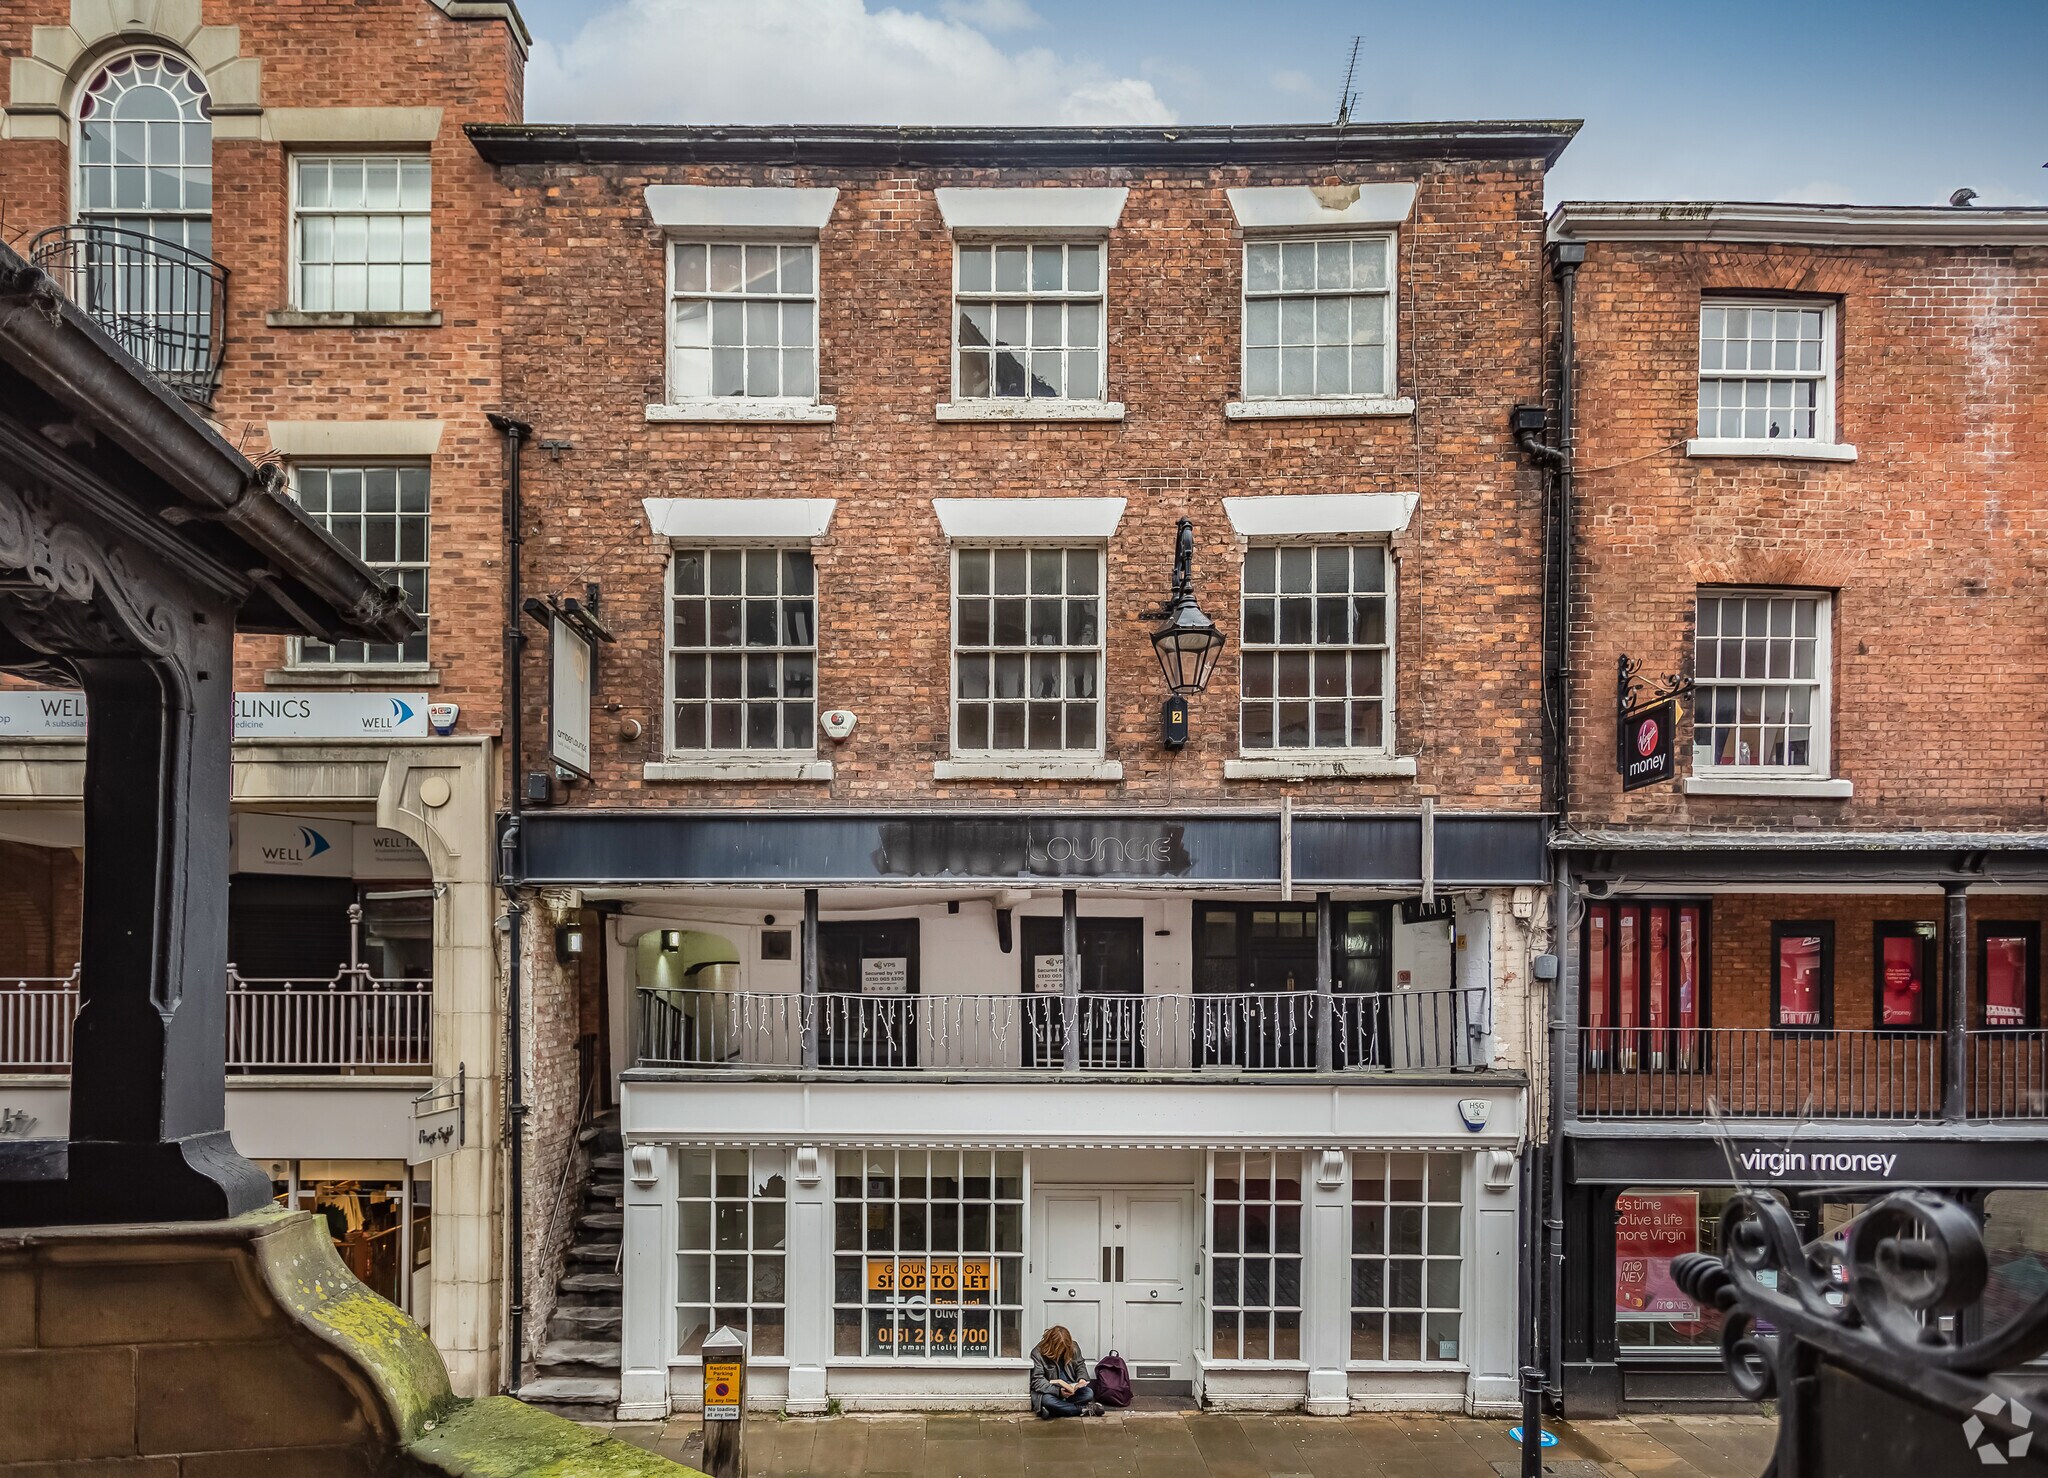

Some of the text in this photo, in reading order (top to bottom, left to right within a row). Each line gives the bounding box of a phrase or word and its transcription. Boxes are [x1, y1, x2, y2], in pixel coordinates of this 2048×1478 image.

[362, 717, 392, 729] WELL
[1174, 713, 1181, 722] 2
[1629, 753, 1666, 777] money
[373, 838, 401, 848] WELL
[1028, 836, 1172, 862] LOUNGE
[261, 847, 303, 861] WELL
[1740, 1149, 1897, 1177] virgin money
[1634, 1199, 1661, 1210] time
[1630, 1214, 1651, 1225] live
[1653, 1217, 1661, 1225] a
[1663, 1214, 1682, 1225] life
[1650, 1229, 1686, 1243] Virgin
[884, 1265, 939, 1275] GOUND
[931, 1275, 955, 1289] TO
[963, 1275, 988, 1289] LET
